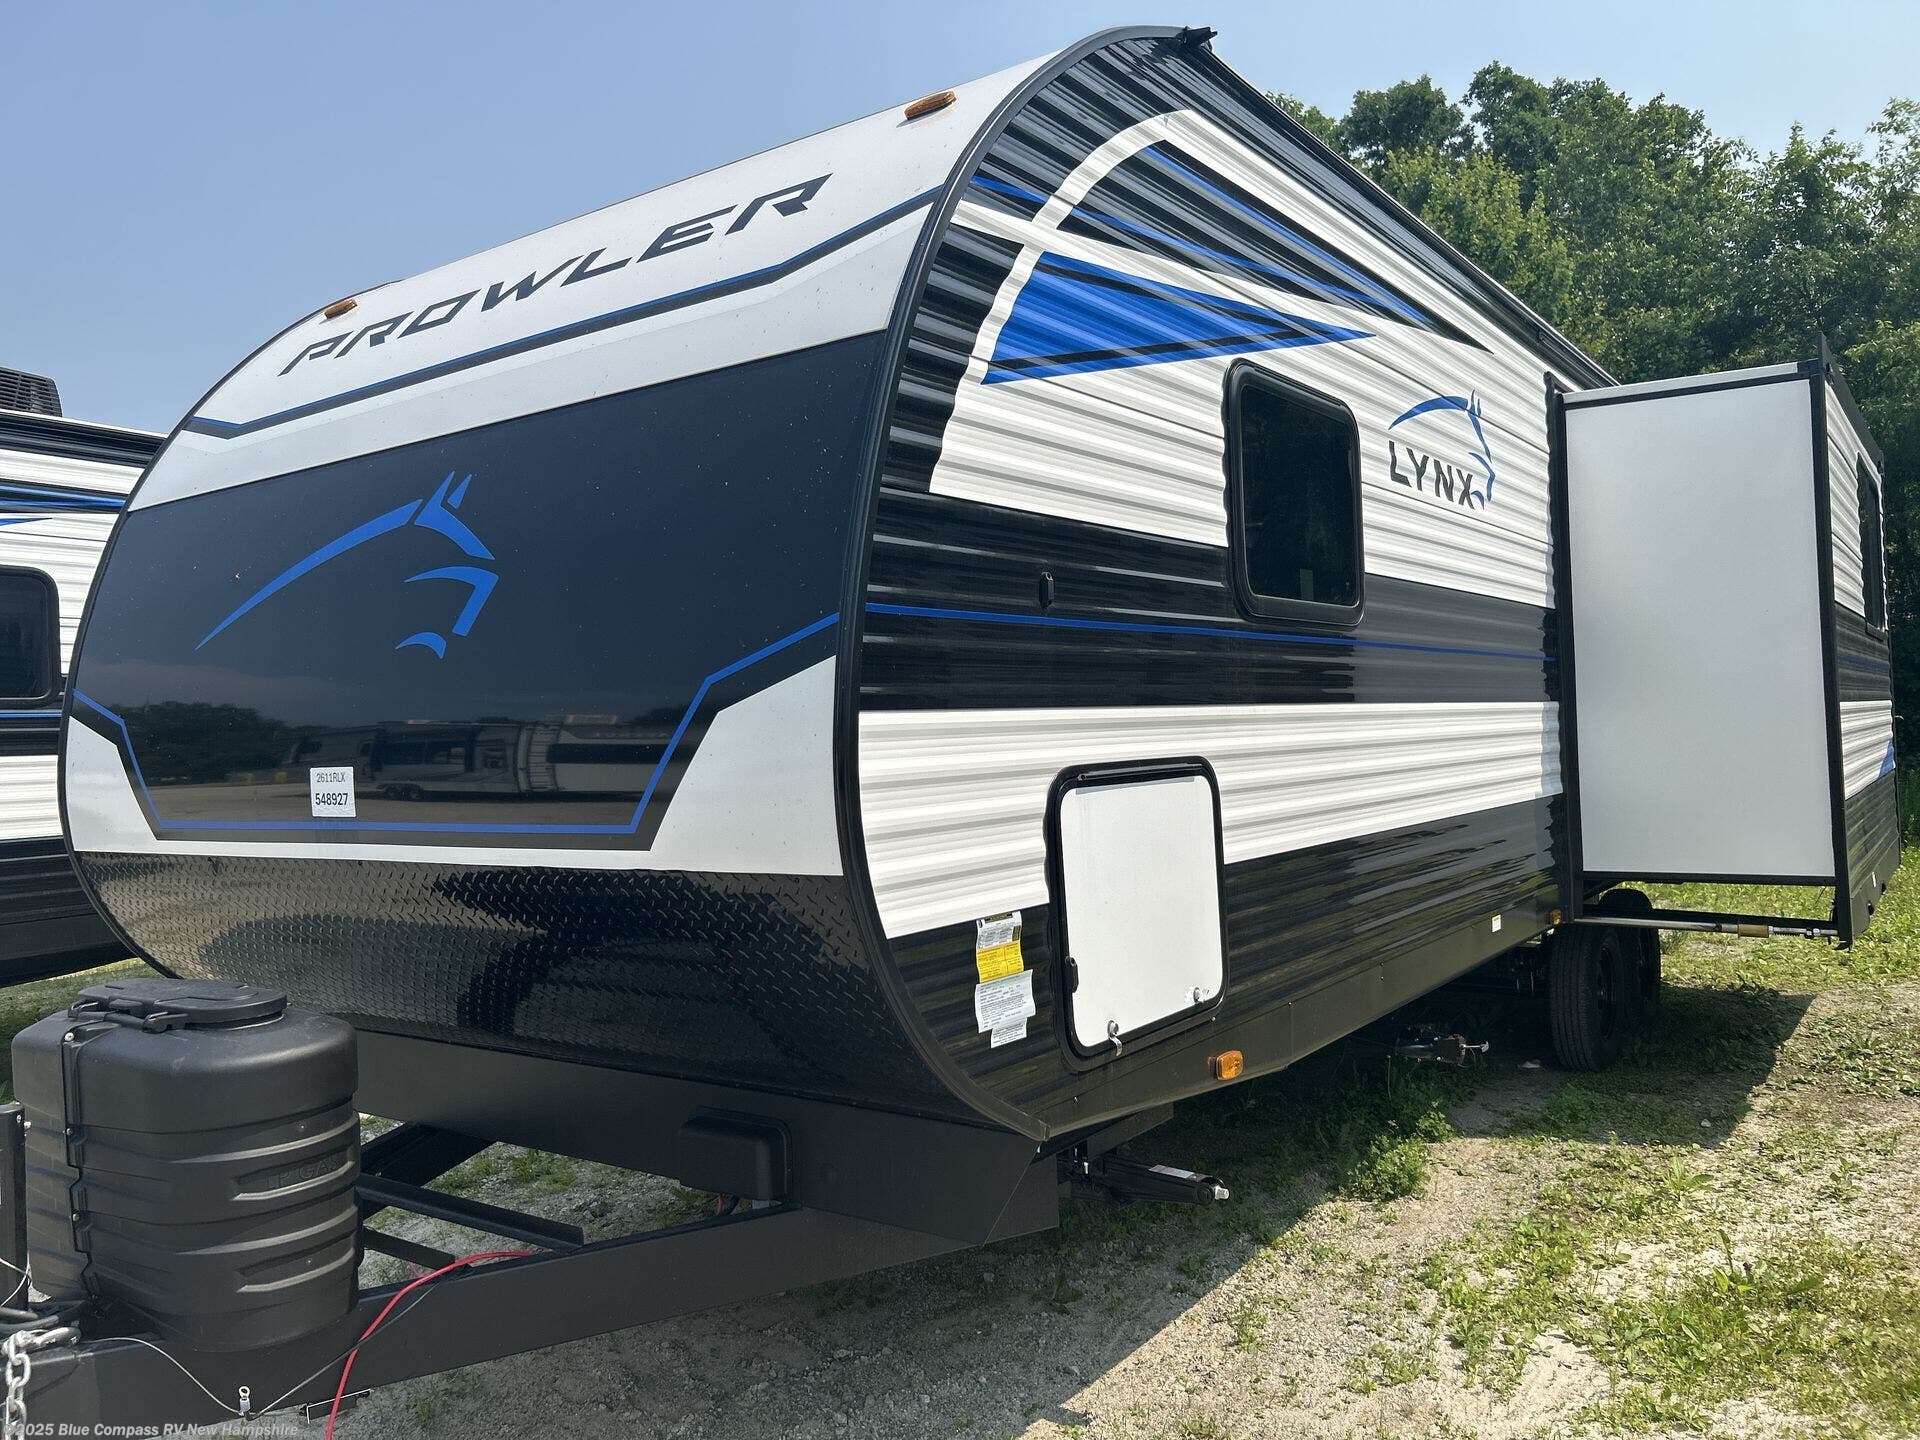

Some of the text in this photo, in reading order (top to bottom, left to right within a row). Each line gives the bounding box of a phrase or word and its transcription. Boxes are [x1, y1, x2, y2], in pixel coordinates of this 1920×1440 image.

[278, 173, 832, 376] PROWLER
[1389, 440, 1475, 510] LYNX
[316, 772, 346, 783] 2611RLX
[315, 792, 348, 806] 548927
